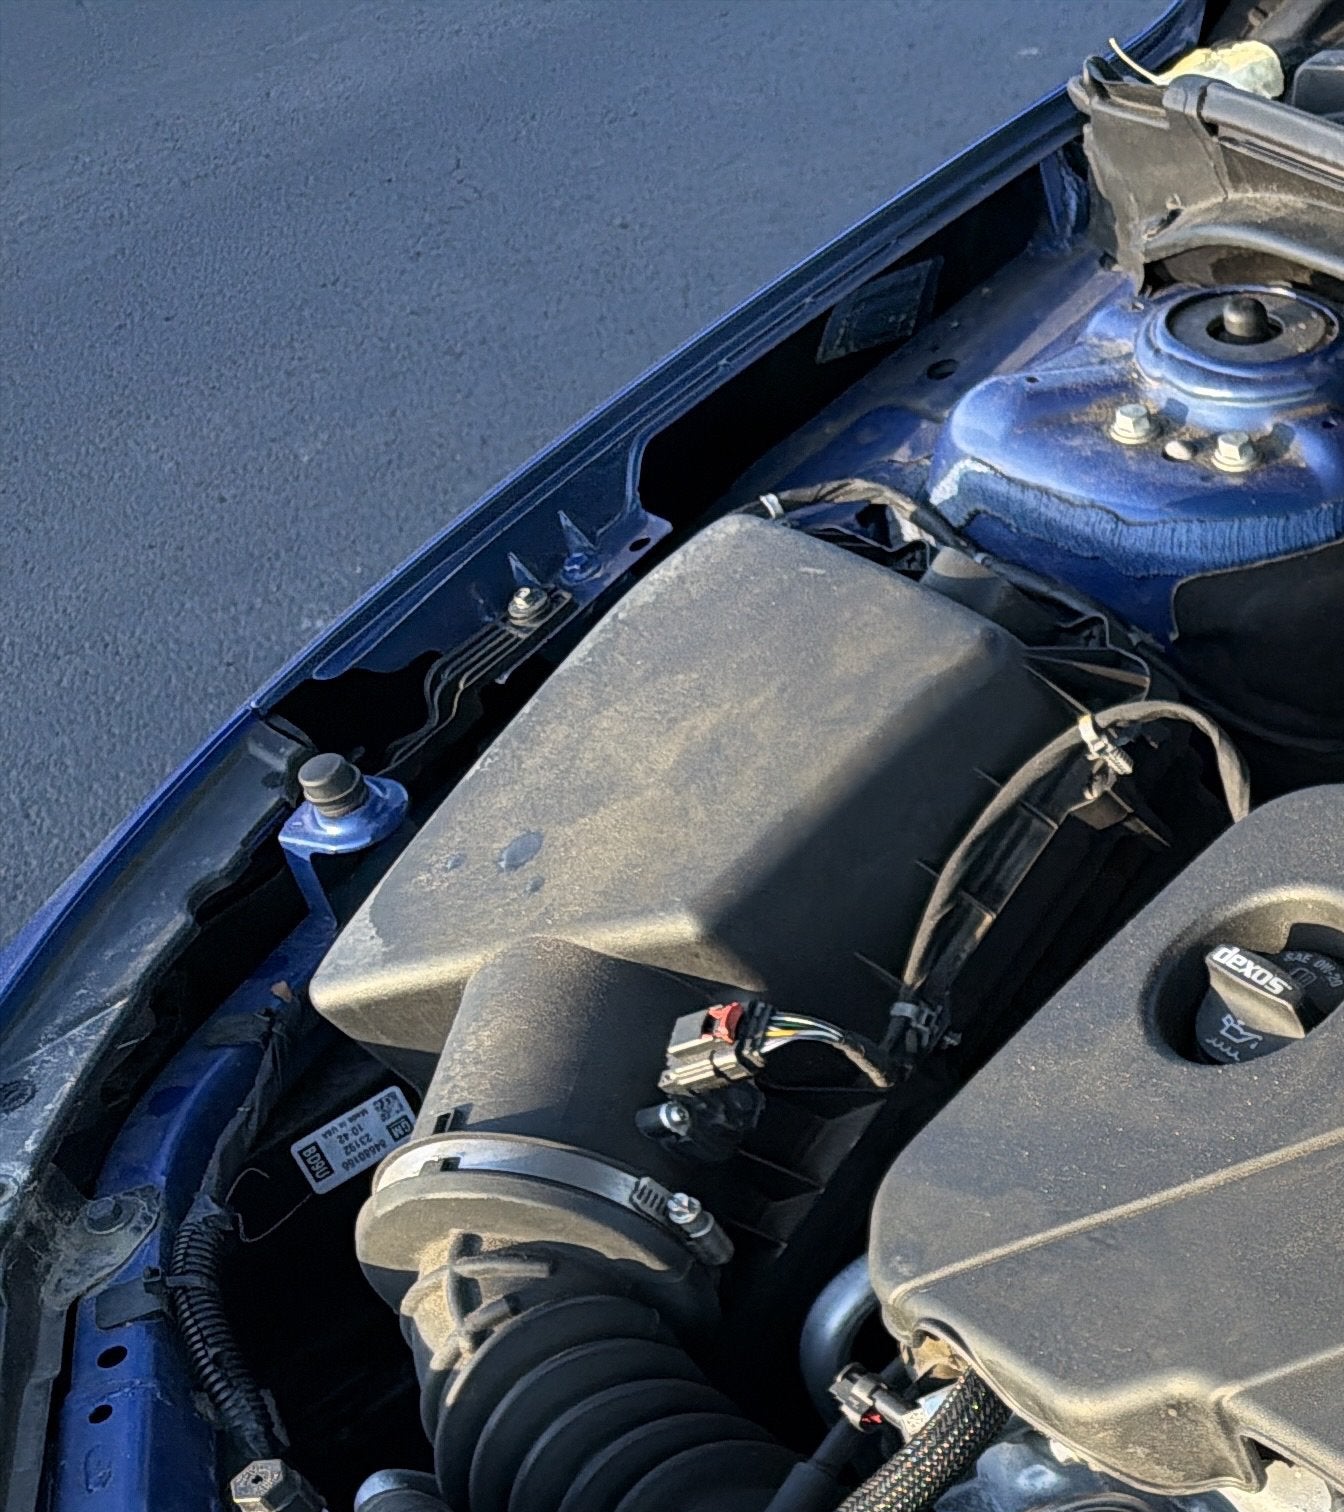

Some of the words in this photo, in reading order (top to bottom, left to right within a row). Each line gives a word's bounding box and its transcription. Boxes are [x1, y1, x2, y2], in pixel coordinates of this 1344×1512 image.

[1283, 952, 1312, 964] SAE
[1212, 946, 1290, 995] dexos
[390, 1119, 411, 1140] GM
